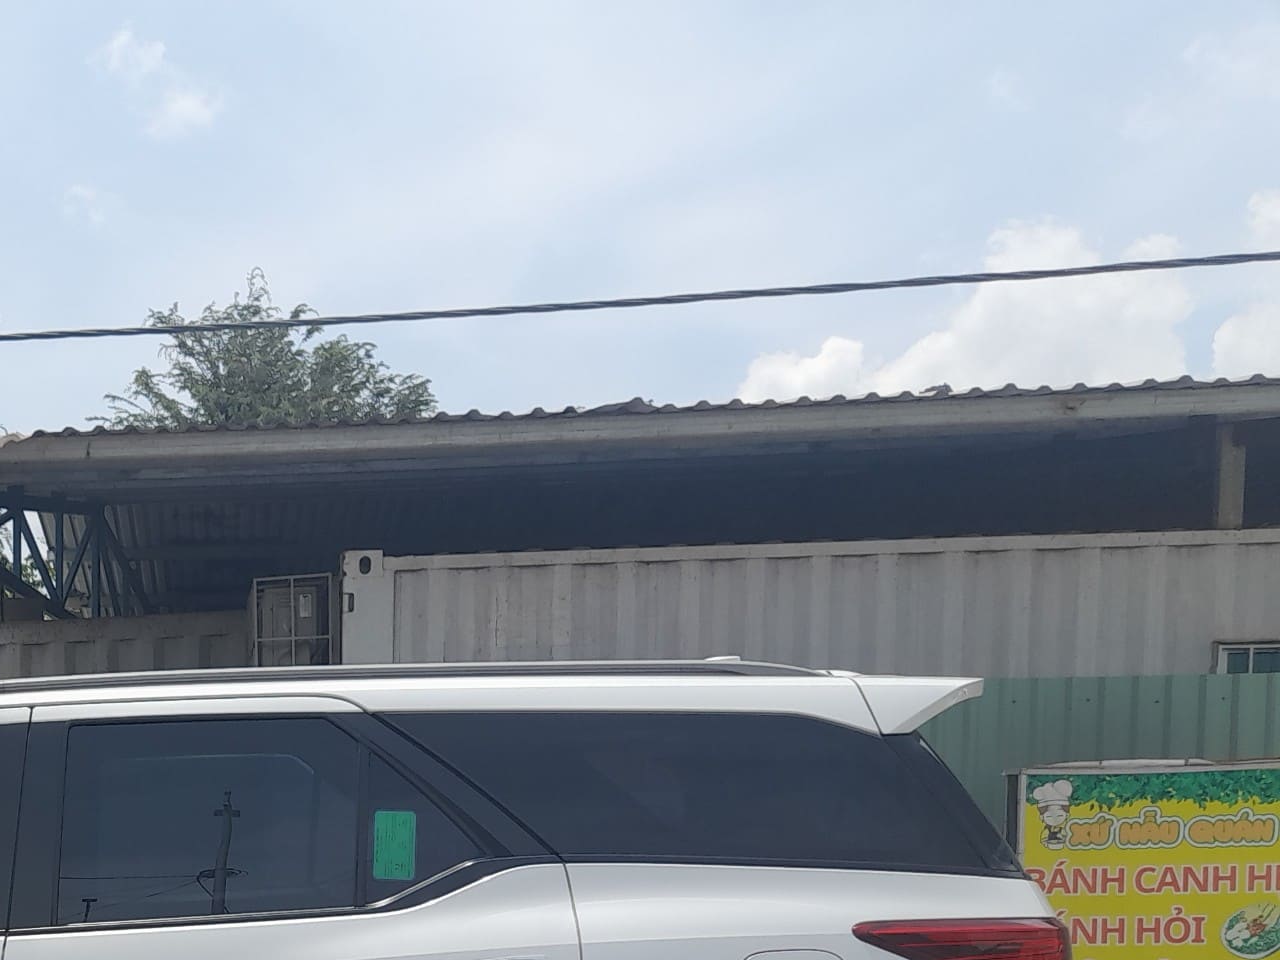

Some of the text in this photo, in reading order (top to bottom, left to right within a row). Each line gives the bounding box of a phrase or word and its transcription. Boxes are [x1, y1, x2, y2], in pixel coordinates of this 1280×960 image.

[1186, 812, 1277, 846] QUÁN
[1134, 865, 1238, 894] CANH
[1247, 864, 1280, 893] H
[1136, 906, 1206, 945] HỎI
